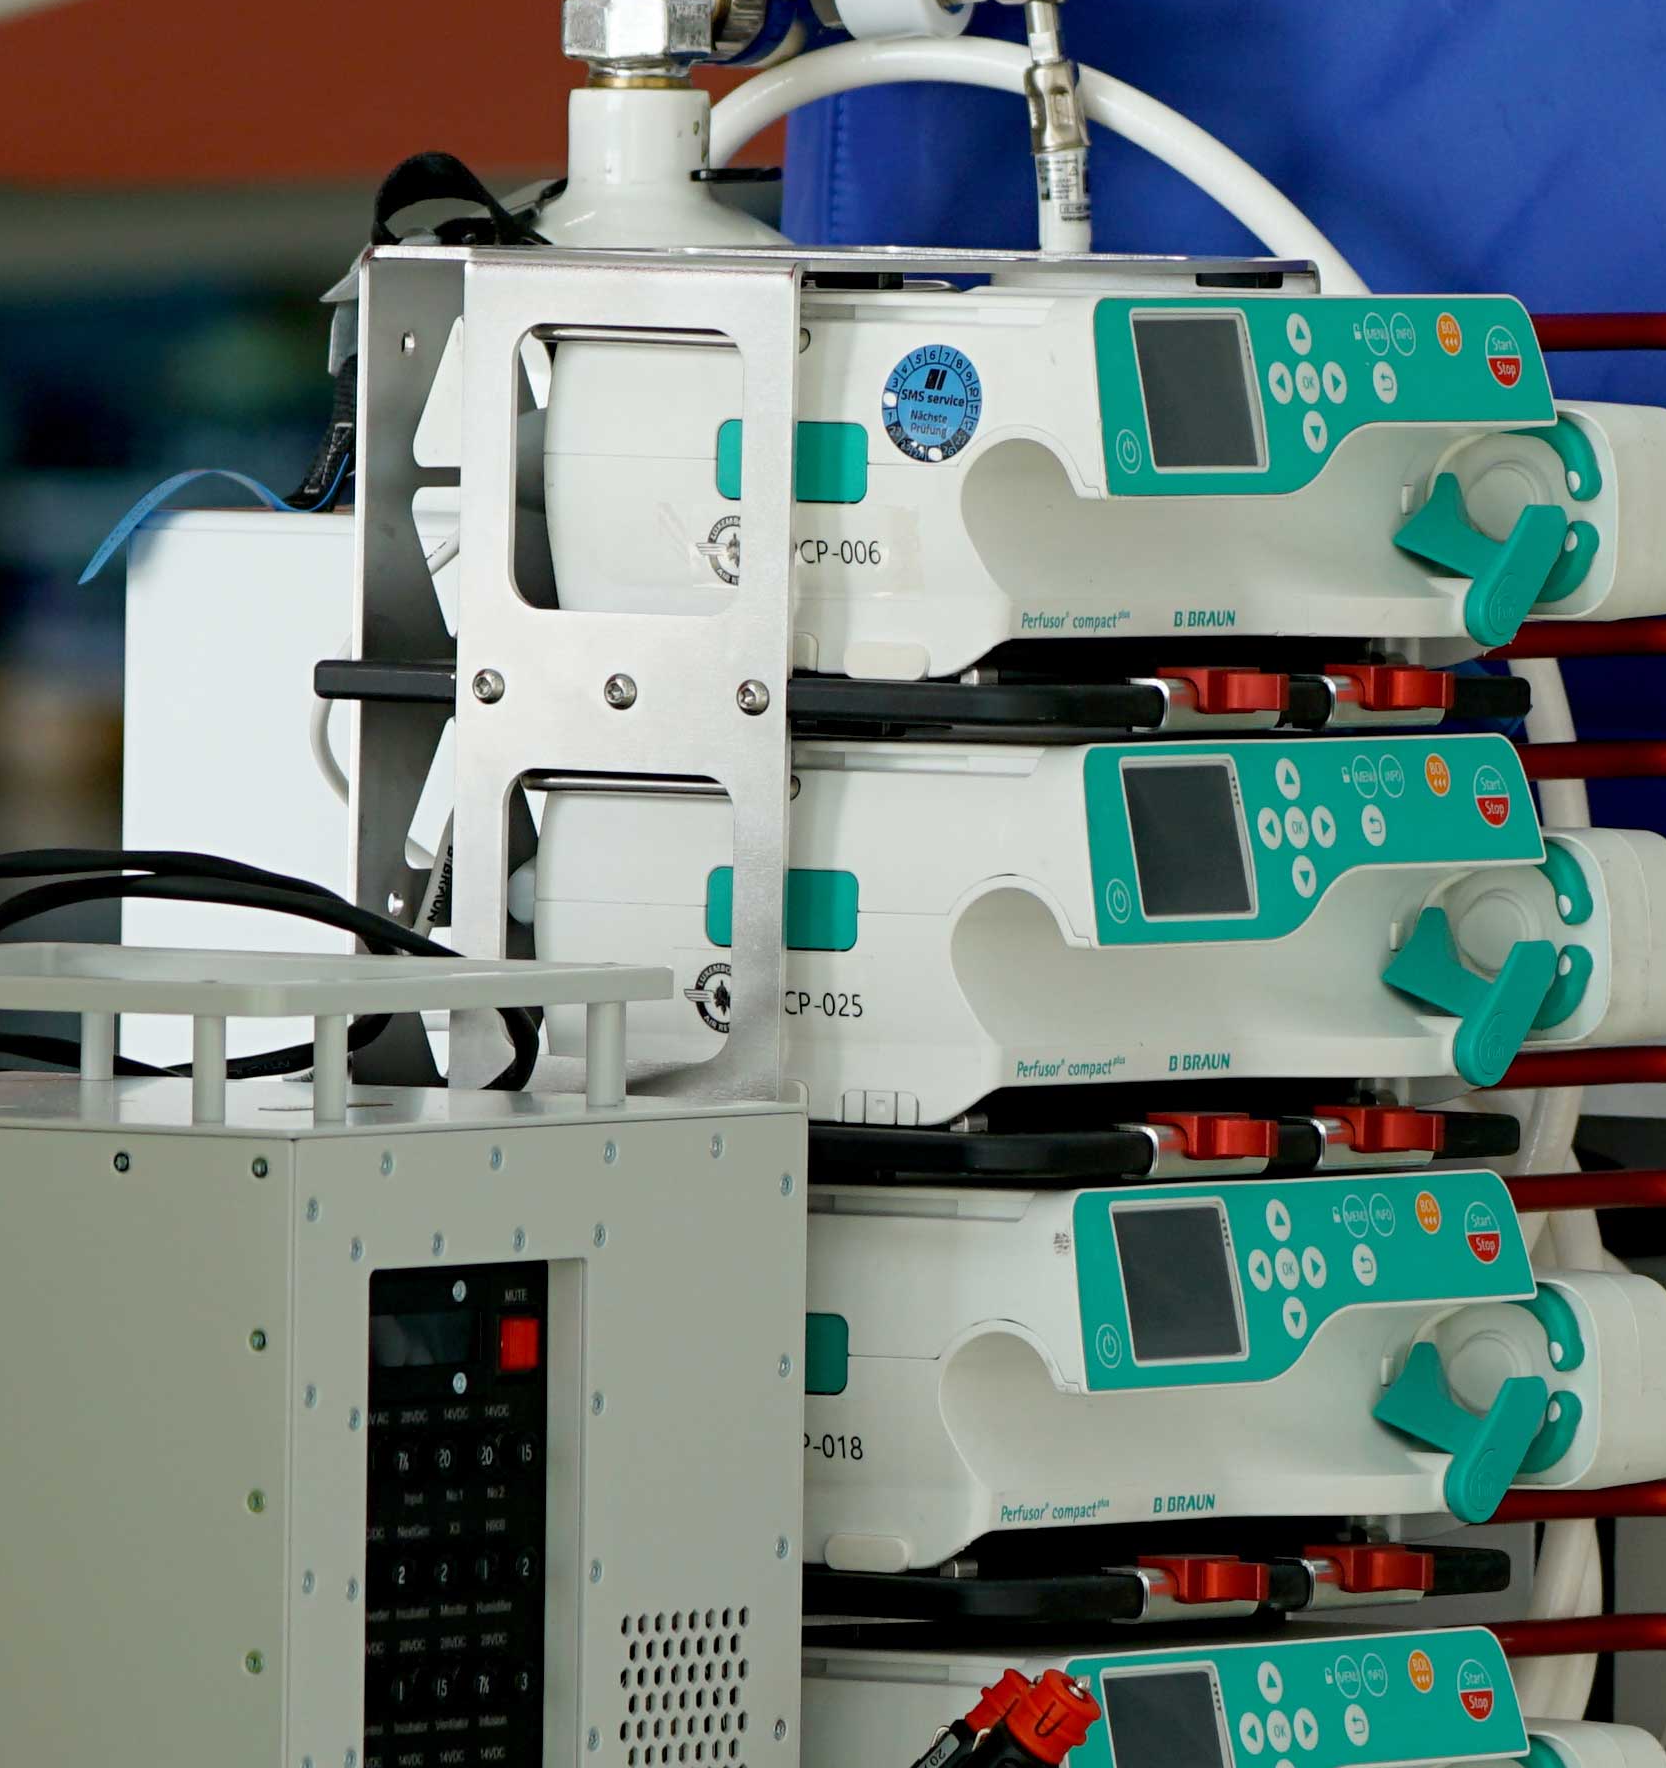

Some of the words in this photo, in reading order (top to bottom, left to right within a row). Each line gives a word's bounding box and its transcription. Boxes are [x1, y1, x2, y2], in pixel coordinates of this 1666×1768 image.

[1365, 327, 1389, 341] MENU
[1395, 328, 1414, 341] INFO
[1439, 320, 1459, 336] BOL
[1492, 336, 1513, 351] Start
[915, 353, 922, 364] 5
[929, 350, 936, 360] 6
[944, 352, 951, 362] 7
[955, 359, 963, 369] 8
[1496, 360, 1517, 377] Stop
[892, 377, 899, 388] 3
[965, 372, 972, 382] 9
[1302, 375, 1314, 390] OK
[900, 388, 925, 402] SMS
[927, 394, 965, 408] service
[969, 386, 979, 397] 10
[910, 409, 948, 425] Nächste
[910, 422, 948, 439] Prüfung
[794, 539, 881, 565] CP-006
[1187, 610, 1237, 627] BRAUN
[1429, 762, 1446, 775] BOL
[1355, 770, 1378, 783] MENU
[1479, 776, 1502, 791] Start
[1484, 800, 1504, 817] Stop
[1182, 1053, 1231, 1071] BRAUN
[1419, 1199, 1437, 1213] BOL
[1344, 1210, 1368, 1222] MENU
[1470, 1214, 1493, 1228] Start
[1475, 1237, 1496, 1253] Stop
[1282, 1262, 1294, 1275] OK
[503, 1288, 528, 1302] MUTE
[443, 1406, 469, 1422] 14VDC
[484, 1403, 510, 1419] 14VDC
[439, 1448, 451, 1468] 20
[481, 1446, 493, 1466] 20
[521, 1444, 533, 1462] 15
[1167, 1494, 1216, 1512] BRAUN
[440, 1562, 449, 1582] 2
[522, 1557, 530, 1576] 2
[398, 1566, 406, 1585] 2
[1412, 1658, 1429, 1672] BOL
[520, 1672, 529, 1691] 3
[1337, 1671, 1359, 1683] MENU
[1463, 1671, 1486, 1686] Start
[436, 1677, 448, 1697] 15
[1468, 1695, 1489, 1712] Stop
[1273, 1723, 1287, 1739] OK
[398, 1753, 424, 1766] 14VDC
[439, 1750, 465, 1764] 14VDC
[480, 1746, 506, 1760] 14VDC
[930, 1748, 947, 1767] 20
